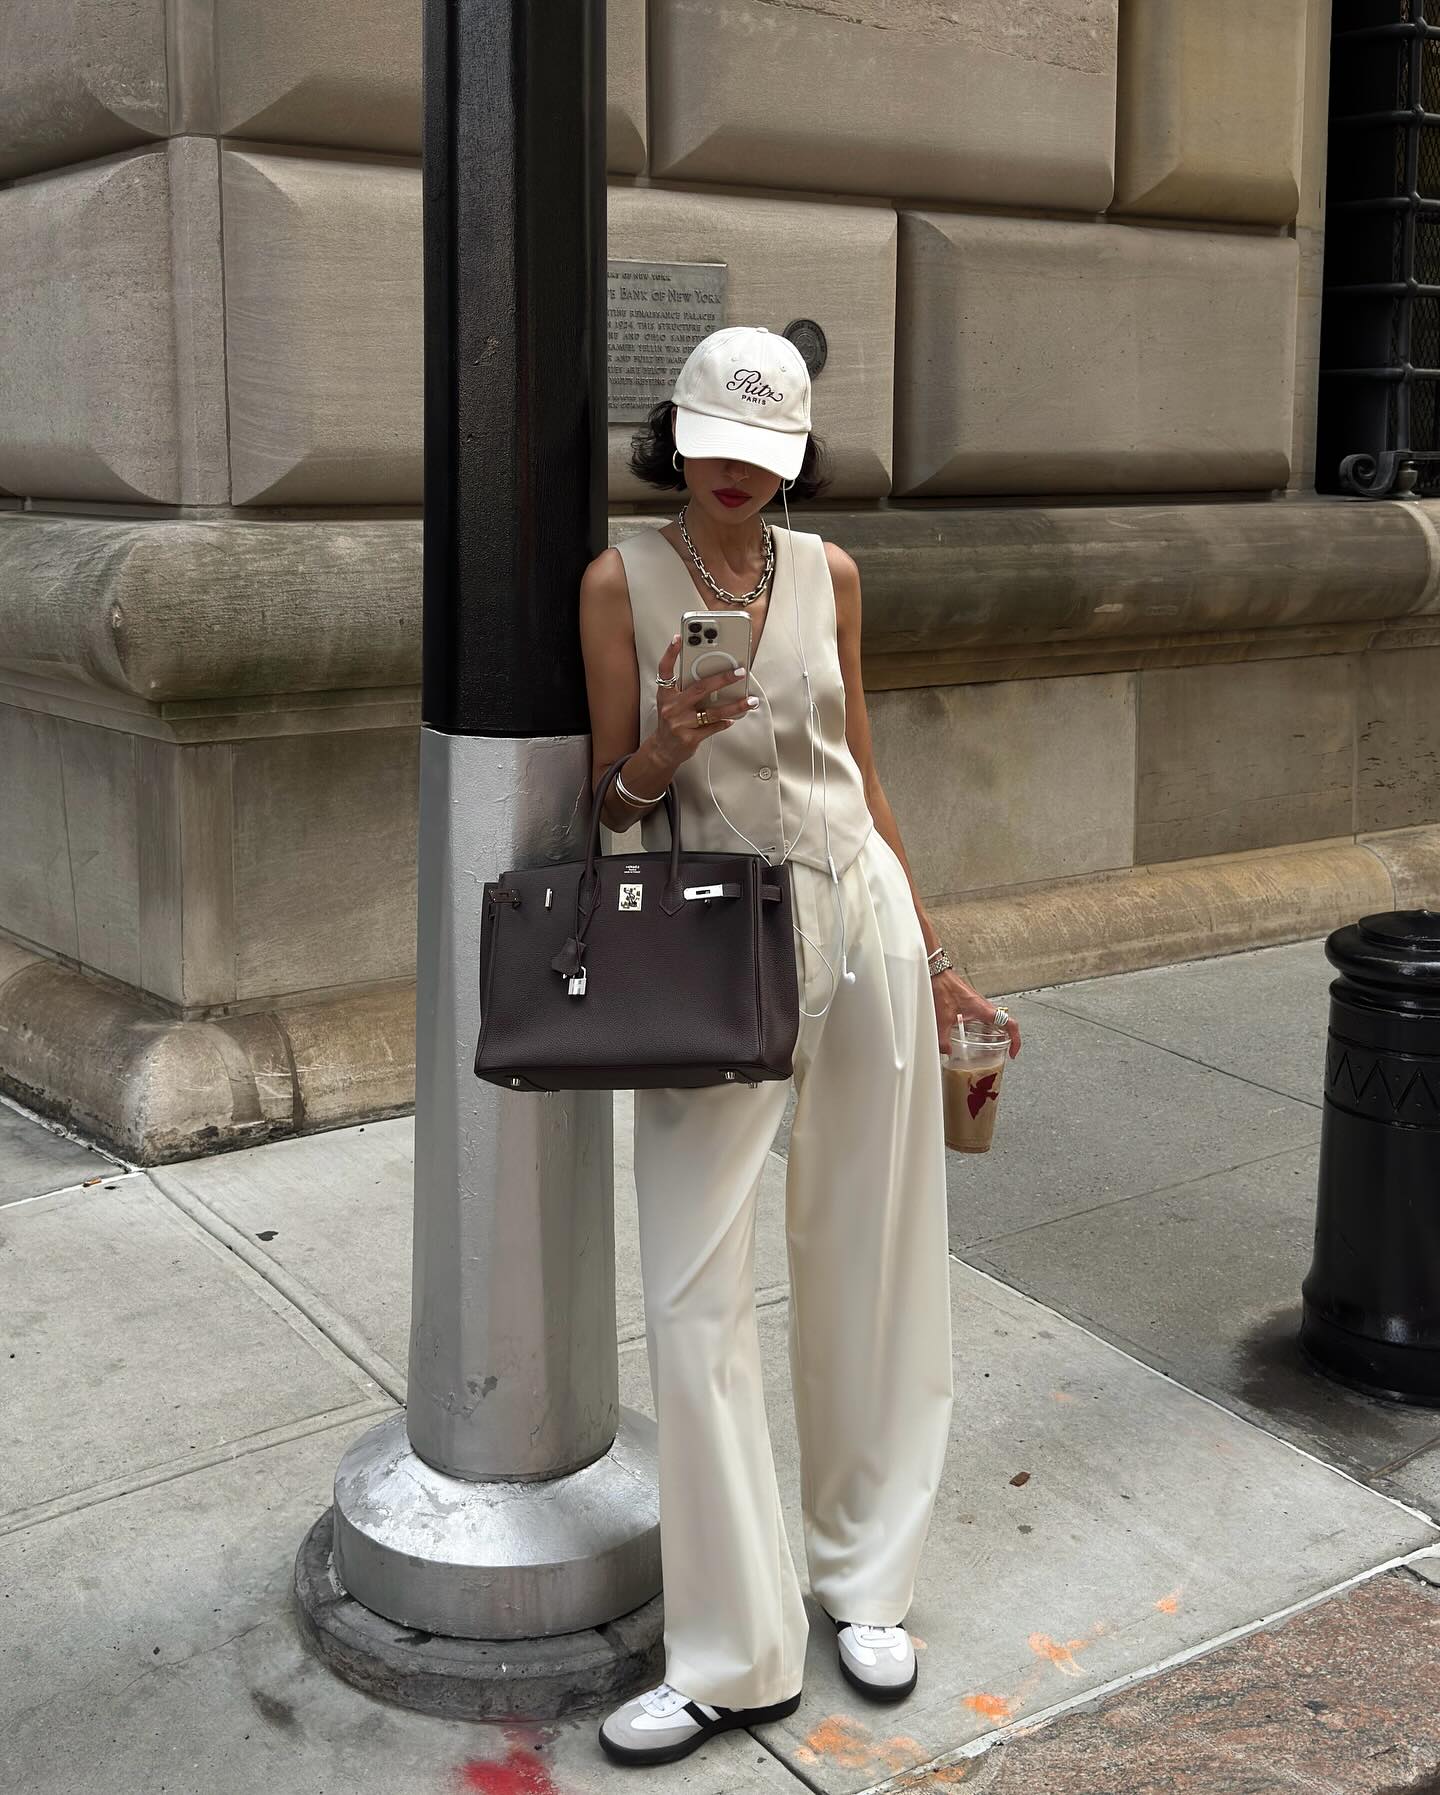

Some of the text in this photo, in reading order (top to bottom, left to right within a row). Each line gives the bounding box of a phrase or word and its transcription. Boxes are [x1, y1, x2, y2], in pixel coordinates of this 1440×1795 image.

[620, 287, 648, 301] BANK
[651, 291, 665, 301] OF
[667, 289, 692, 303] NEW
[694, 290, 721, 304] YORK
[629, 310, 680, 320] RENAISSANCE
[683, 312, 715, 321] PALACES
[637, 322, 655, 330] THIS
[658, 322, 701, 331] STRUCTURE
[622, 333, 640, 341] AND
[644, 333, 666, 343] OHIO
[726, 369, 783, 402] Ritz
[741, 395, 766, 406] PARIS
